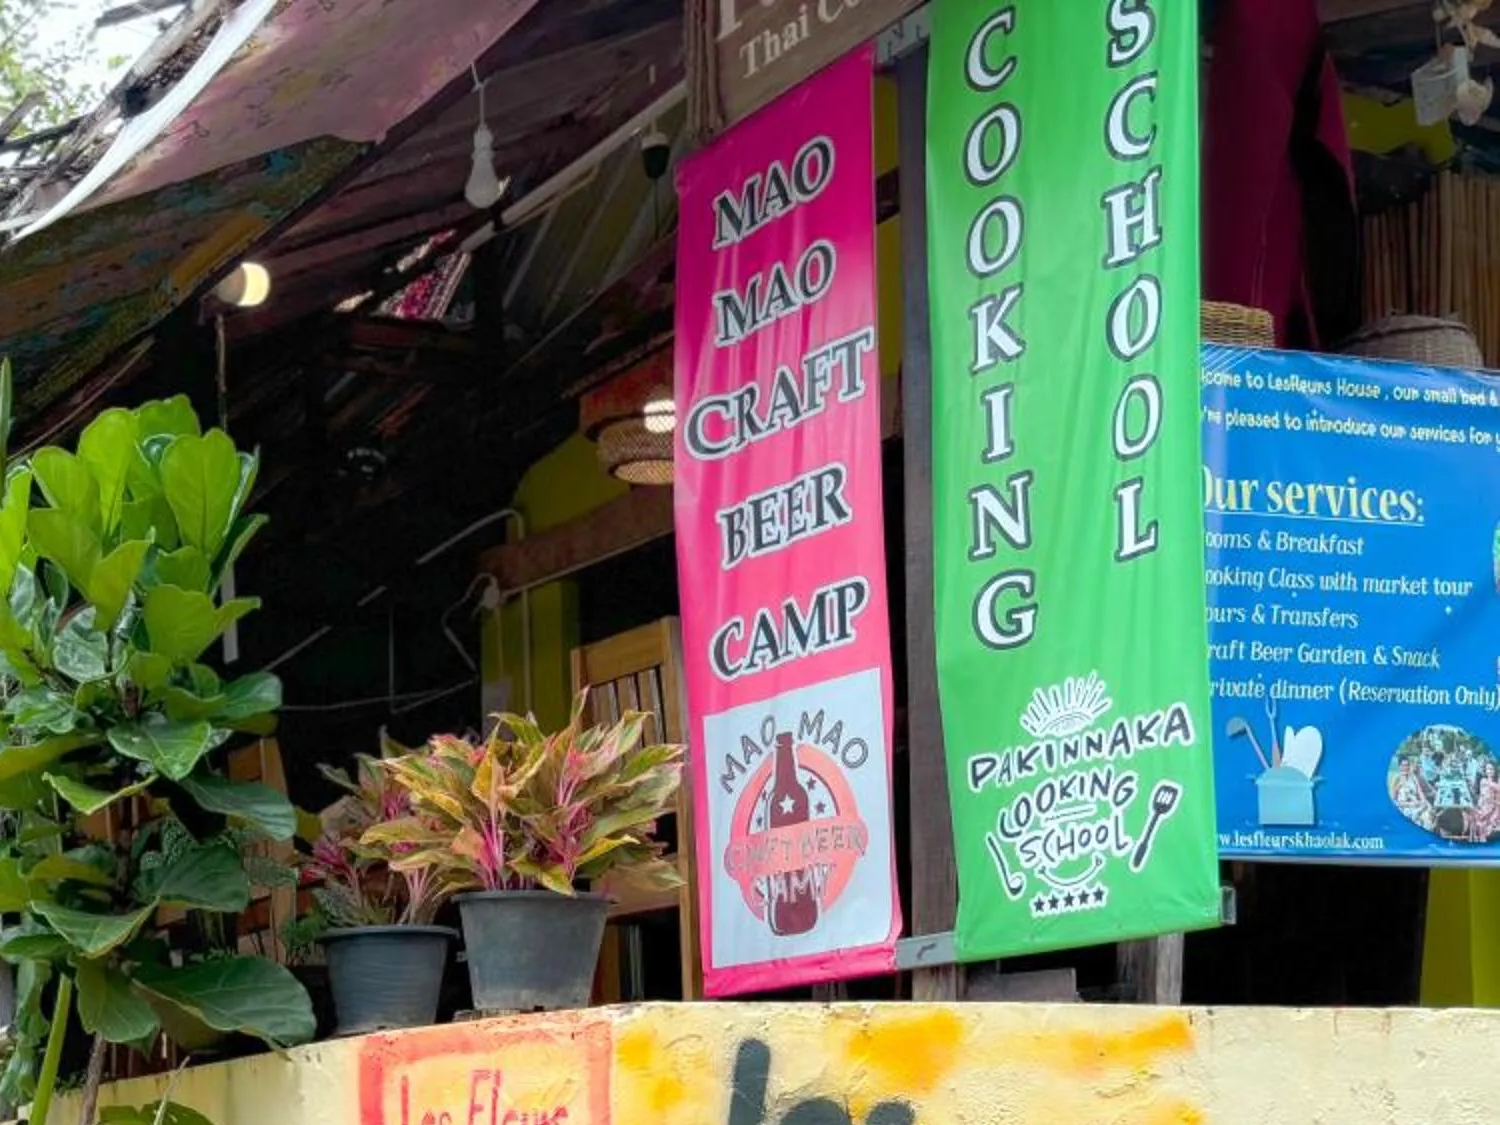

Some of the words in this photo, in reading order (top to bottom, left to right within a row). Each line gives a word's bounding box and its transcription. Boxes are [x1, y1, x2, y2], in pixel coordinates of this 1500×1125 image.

[740, 2, 810, 79] Thai
[712, 135, 836, 250] MAO
[712, 239, 836, 348] MAO
[1102, 0, 1162, 562] SCHOOL
[963, 5, 1038, 650] COOKING
[684, 327, 875, 461] CRAFT
[1201, 367, 1242, 388] lcome
[1245, 370, 1264, 390] to
[1337, 379, 1381, 400] House
[1225, 407, 1280, 430] pleased
[1283, 411, 1303, 431] to
[1306, 410, 1377, 437] introduce
[1410, 423, 1466, 444] services
[716, 461, 853, 570] BEER
[1267, 476, 1425, 523] services:
[1205, 531, 1251, 549] ooms
[1257, 529, 1272, 551] &
[1276, 531, 1365, 556] Breakfast
[1205, 564, 1264, 592] ooking
[1268, 567, 1315, 590] Class
[1319, 571, 1358, 593] with
[1363, 575, 1429, 596] market
[1433, 577, 1474, 596] tour
[710, 575, 869, 682] CAMP
[1206, 606, 1246, 623] ours
[1251, 603, 1266, 625] &
[1270, 605, 1359, 629] Transfers
[1207, 639, 1245, 660] raft
[1250, 640, 1293, 662] Beer
[1297, 643, 1367, 666] Garden
[1373, 646, 1388, 667] &
[1391, 646, 1441, 669] Snack
[1209, 676, 1266, 699] rivate
[1269, 678, 1334, 701] dinner
[1339, 677, 1450, 705] (Reservation
[719, 714, 776, 795] MAO
[800, 708, 870, 770] MAO
[969, 703, 1194, 793] PAKINNAKA
[1000, 769, 1138, 840] COOKING
[1018, 812, 1127, 866] SCHOOL
[1219, 831, 1384, 850] w.lesfleurskhaolak.com
